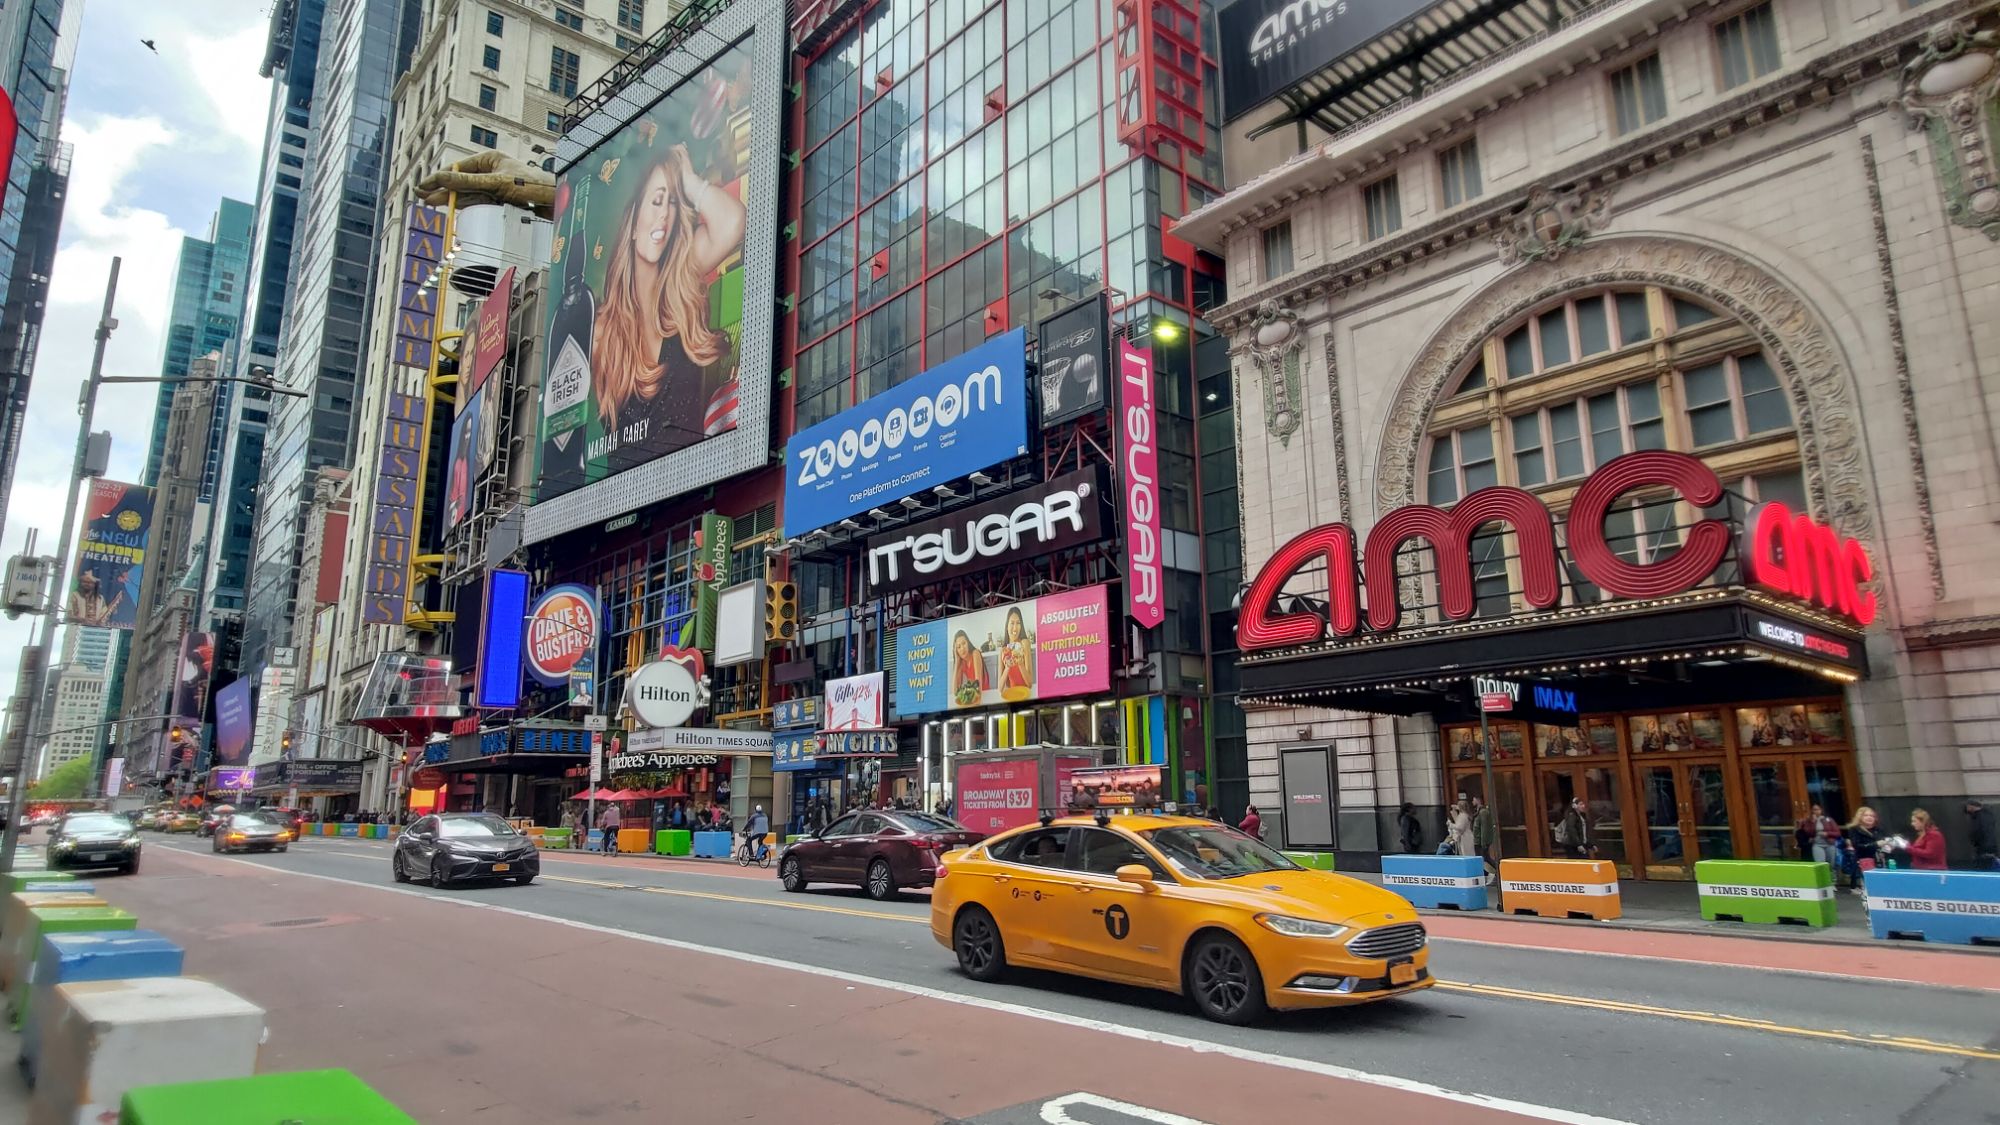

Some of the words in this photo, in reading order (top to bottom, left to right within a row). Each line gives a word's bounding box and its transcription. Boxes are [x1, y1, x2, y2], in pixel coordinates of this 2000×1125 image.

[1251, 2, 1347, 67] THEATRES
[402, 207, 441, 367] MADAME
[551, 368, 583, 393] BLACK
[552, 382, 580, 404] IRISH
[587, 431, 619, 460] MARIAH
[623, 418, 650, 442] CAREY
[849, 493, 863, 503] One
[862, 480, 893, 499] Platform
[892, 478, 900, 488] to
[900, 466, 931, 484] Connect
[1125, 352, 1159, 606] IT'SUGAR
[376, 396, 417, 622] TUSSAUDS
[101, 531, 139, 546] NEW
[80, 551, 130, 564] THEATER
[708, 519, 727, 592] Applebee's
[1236, 450, 1733, 652] amc
[1749, 500, 1877, 628] amc
[1041, 603, 1100, 624] ABSOLUTELY
[536, 607, 575, 640] DAVE
[576, 605, 589, 627] &
[1062, 623, 1078, 635] NO
[912, 633, 930, 646] YOU
[1759, 620, 1795, 644] WELCOME
[1794, 633, 1805, 647] TO
[1041, 634, 1101, 652] NUTRITIONAL
[908, 646, 934, 661] KNOW
[1055, 650, 1086, 664] VALUE
[912, 663, 930, 674] YOU
[1054, 664, 1088, 679] ADDED
[909, 675, 934, 689] WANT
[1477, 677, 1520, 702] DOLBY
[640, 686, 690, 702] Hilton
[916, 690, 925, 702] IT
[1533, 686, 1577, 712] IMAX
[675, 733, 713, 745] Hilton
[717, 737, 743, 746] TIMES
[745, 738, 774, 747] SQUAR
[850, 732, 898, 752] GIFTS
[963, 789, 1005, 801] BROADWAY
[1009, 790, 1030, 807] $39
[963, 801, 988, 809] TICKETS
[989, 800, 1006, 809] FROM
[1392, 876, 1420, 884] TIMES
[1421, 877, 1456, 886] SQUARE
[1510, 882, 1542, 892] TIMES
[1544, 884, 1585, 894] SQUARE
[1709, 886, 1748, 897] TIMES
[1751, 887, 1800, 899] SQUARE
[1883, 899, 1932, 912] TIMES
[1937, 901, 2000, 915] SQUARE
